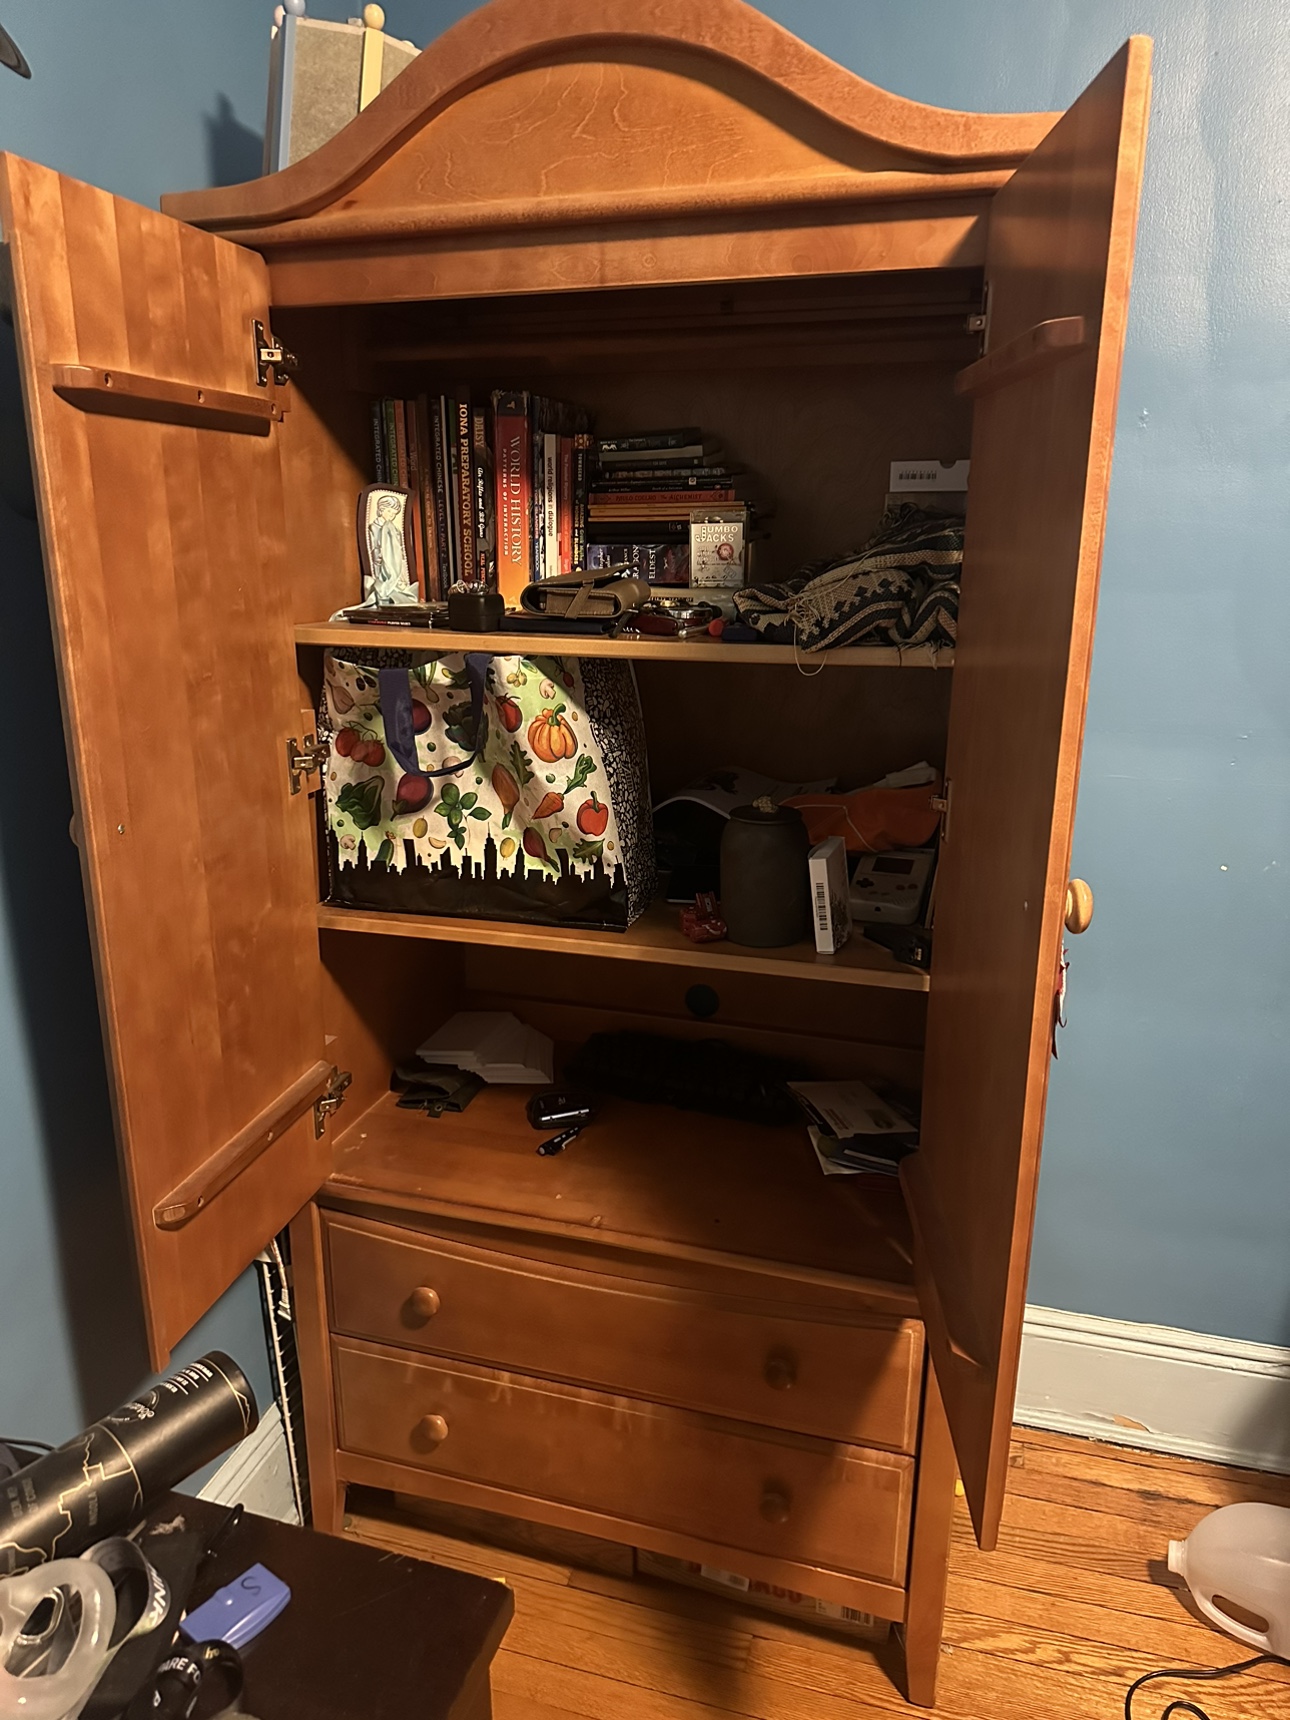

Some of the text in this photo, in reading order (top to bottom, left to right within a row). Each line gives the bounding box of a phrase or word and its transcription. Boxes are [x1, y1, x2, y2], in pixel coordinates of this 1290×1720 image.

[474, 416, 485, 447] DAISY
[459, 404, 473, 576] IONA PREPARATORY SCHOOL
[477, 478, 486, 496] Rifles
[503, 492, 508, 501] OF
[510, 436, 522, 567] WORLD HISTORY
[696, 534, 734, 542] JACKS
[701, 525, 738, 534] JUMBO
[648, 549, 656, 579] ELDEST
